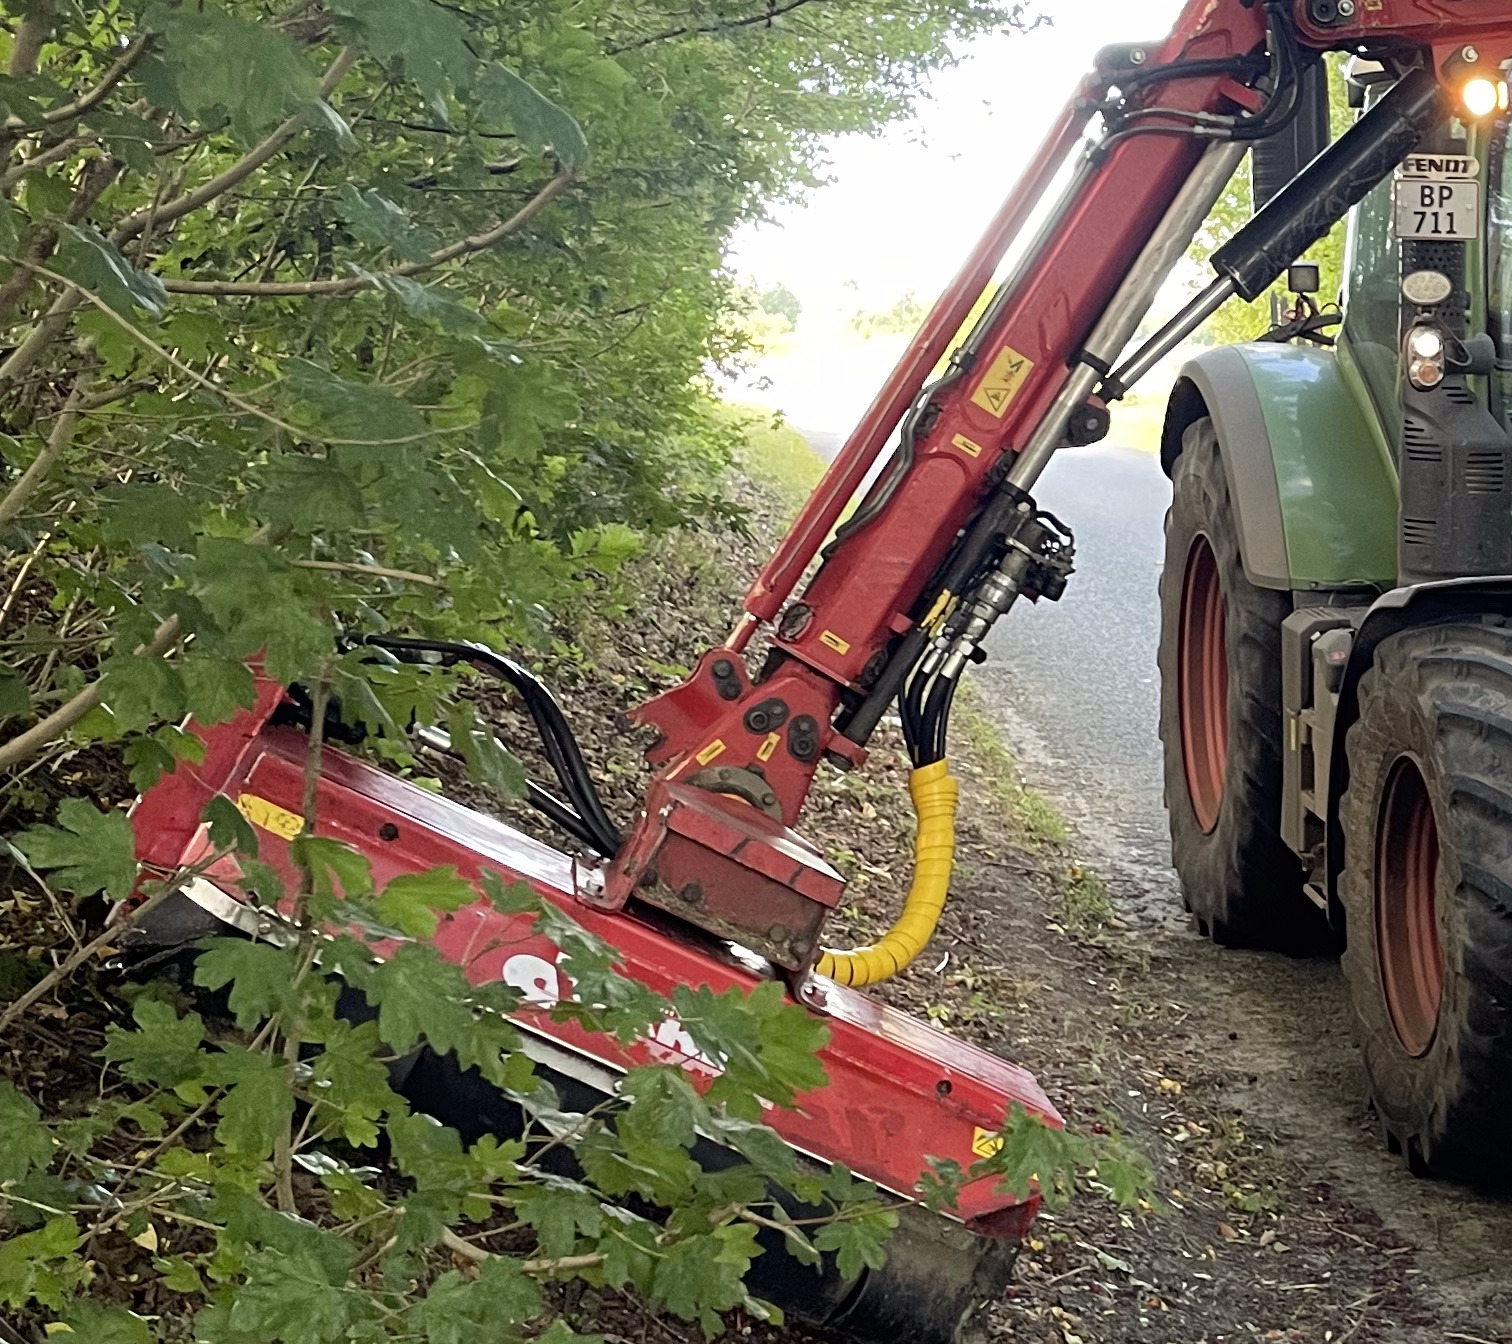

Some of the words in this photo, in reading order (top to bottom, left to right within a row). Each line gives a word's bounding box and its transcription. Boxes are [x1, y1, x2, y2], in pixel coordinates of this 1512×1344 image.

[1403, 158, 1475, 173] FENDT
[1420, 185, 1453, 208] BP
[1413, 211, 1457, 234] 711
